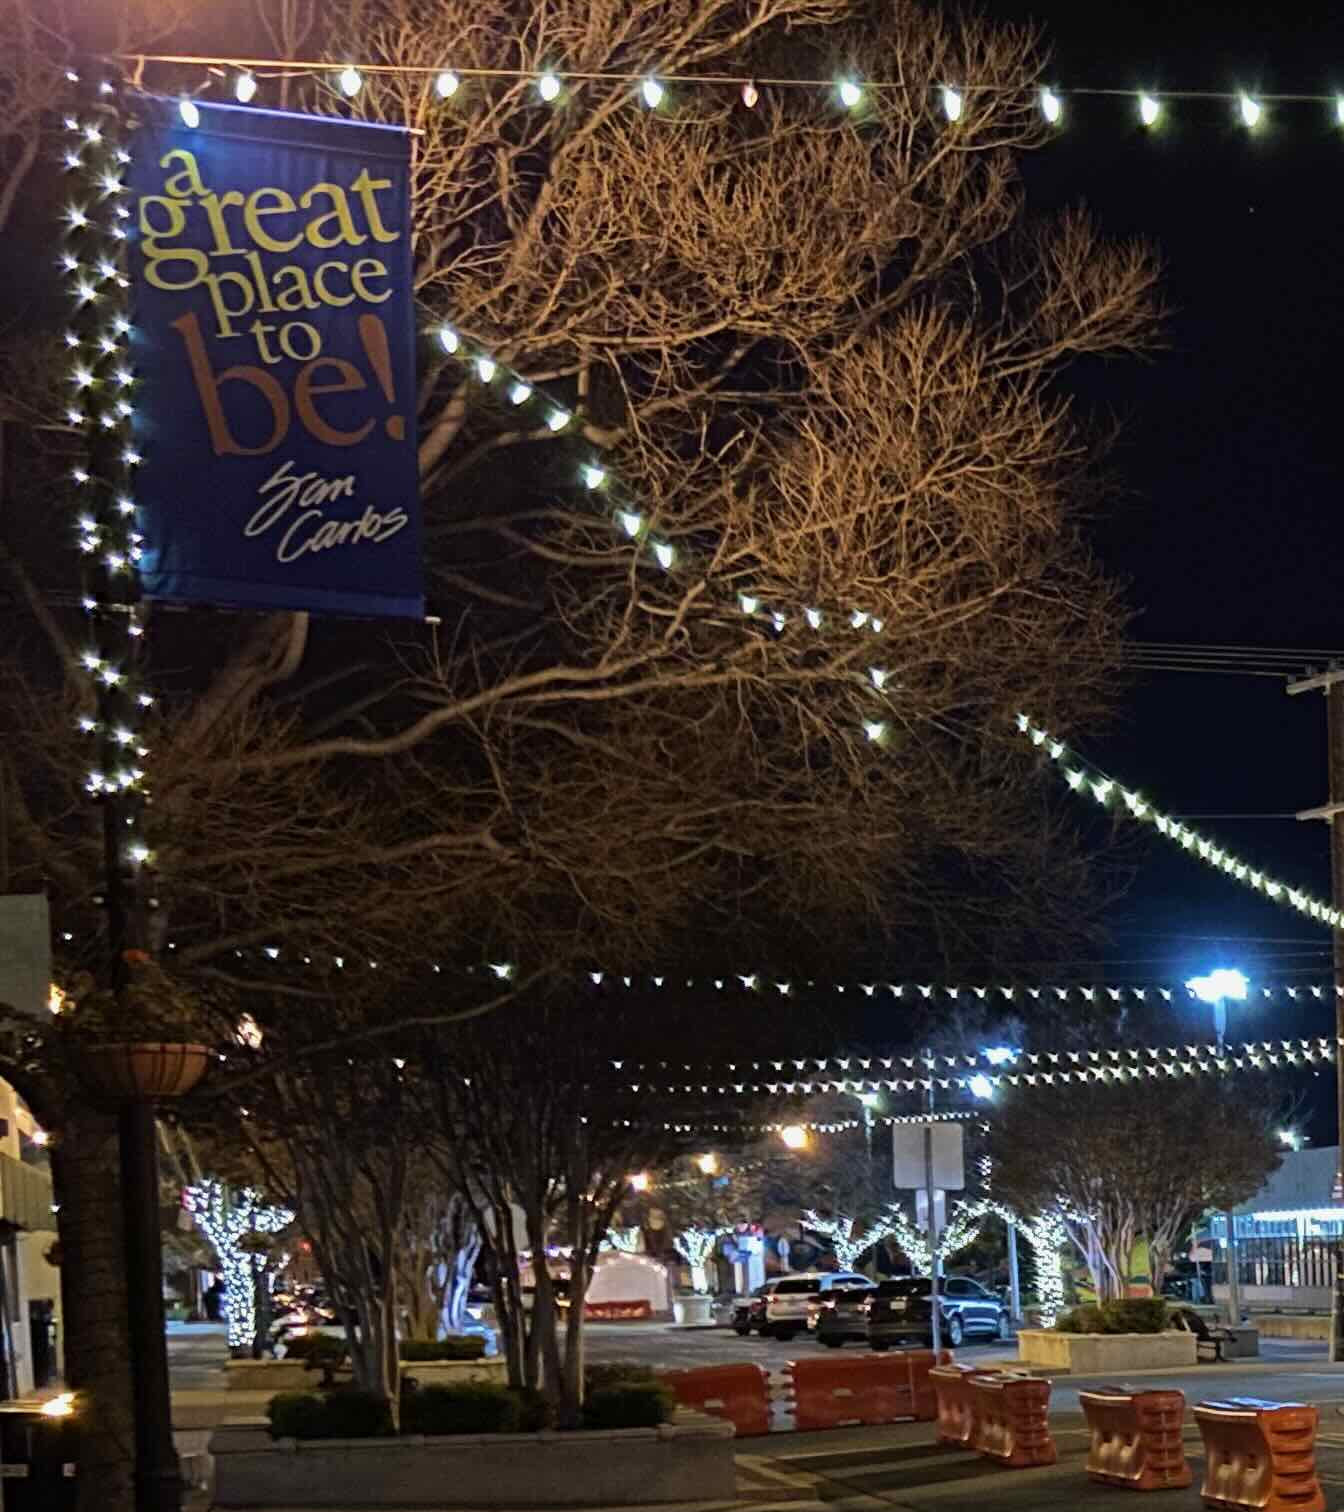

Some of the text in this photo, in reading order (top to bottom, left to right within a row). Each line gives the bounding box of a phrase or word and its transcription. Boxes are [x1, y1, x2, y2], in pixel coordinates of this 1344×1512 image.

[159, 149, 213, 198] a
[139, 167, 400, 291] great
[203, 251, 393, 338] place
[250, 318, 322, 365] to
[169, 311, 406, 457] be!
[243, 460, 356, 537] San
[276, 504, 409, 563] Carlos
